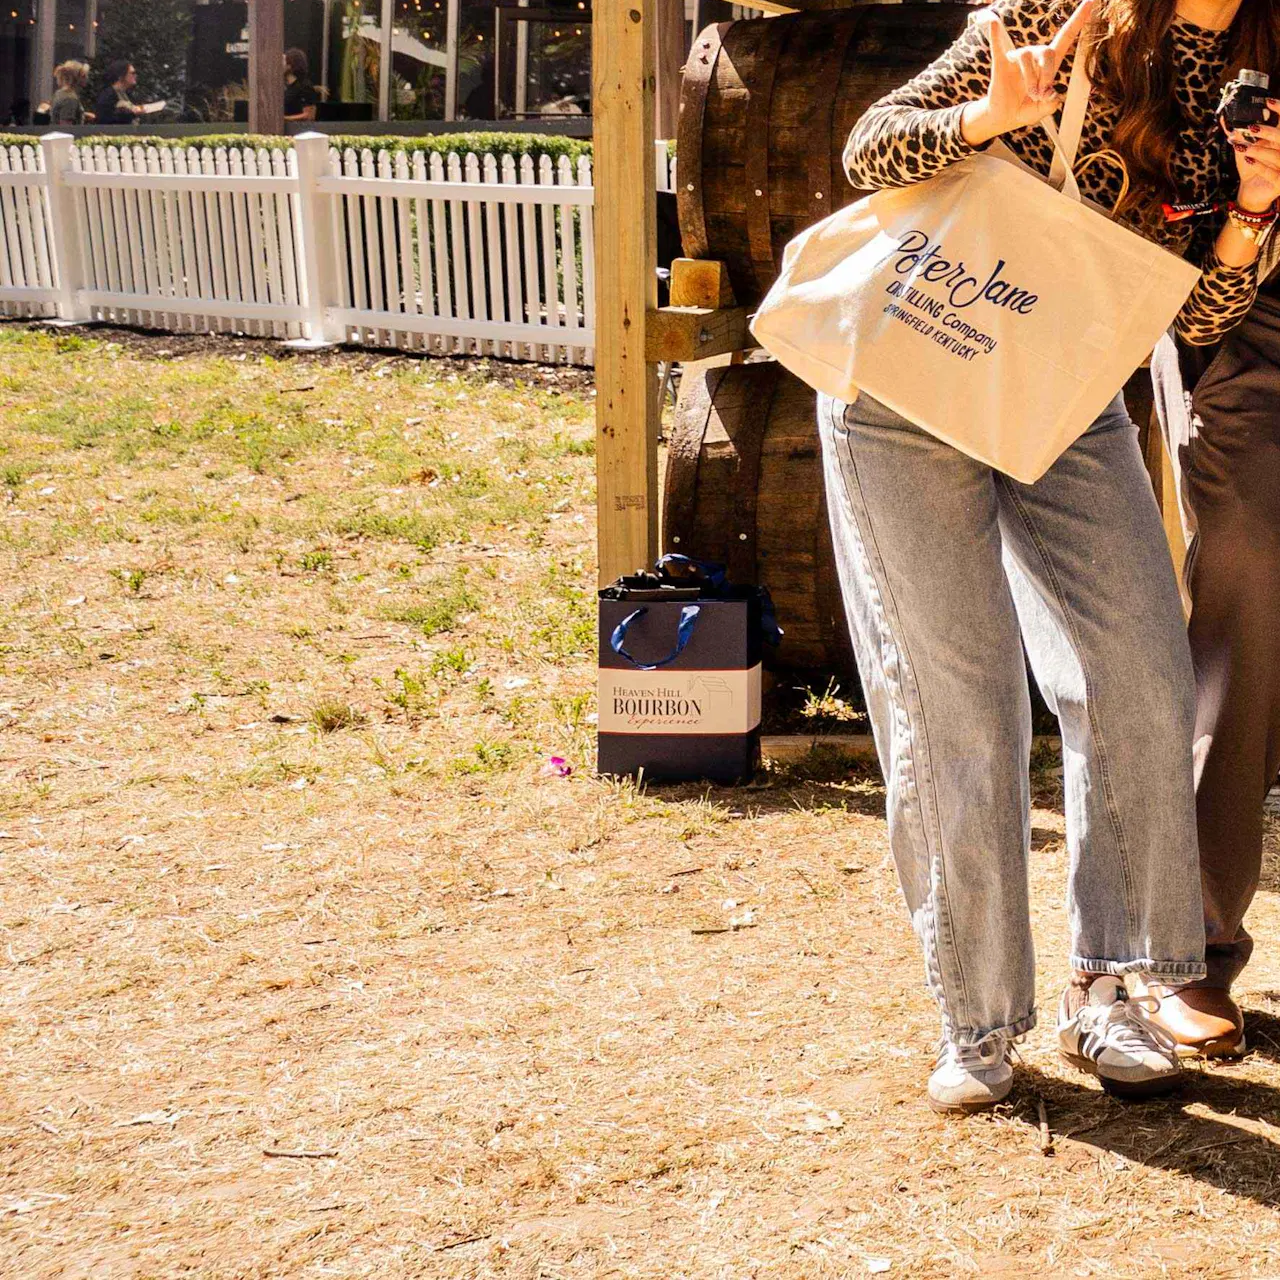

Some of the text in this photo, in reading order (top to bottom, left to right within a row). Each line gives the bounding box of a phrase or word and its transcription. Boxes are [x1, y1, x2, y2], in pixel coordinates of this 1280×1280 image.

[949, 259, 1039, 315] Jane
[883, 303, 980, 362] SPRINGFIELD KENTUCKY
[885, 280, 998, 355] DISTILLING Company
[613, 698, 703, 716] BOURBON
